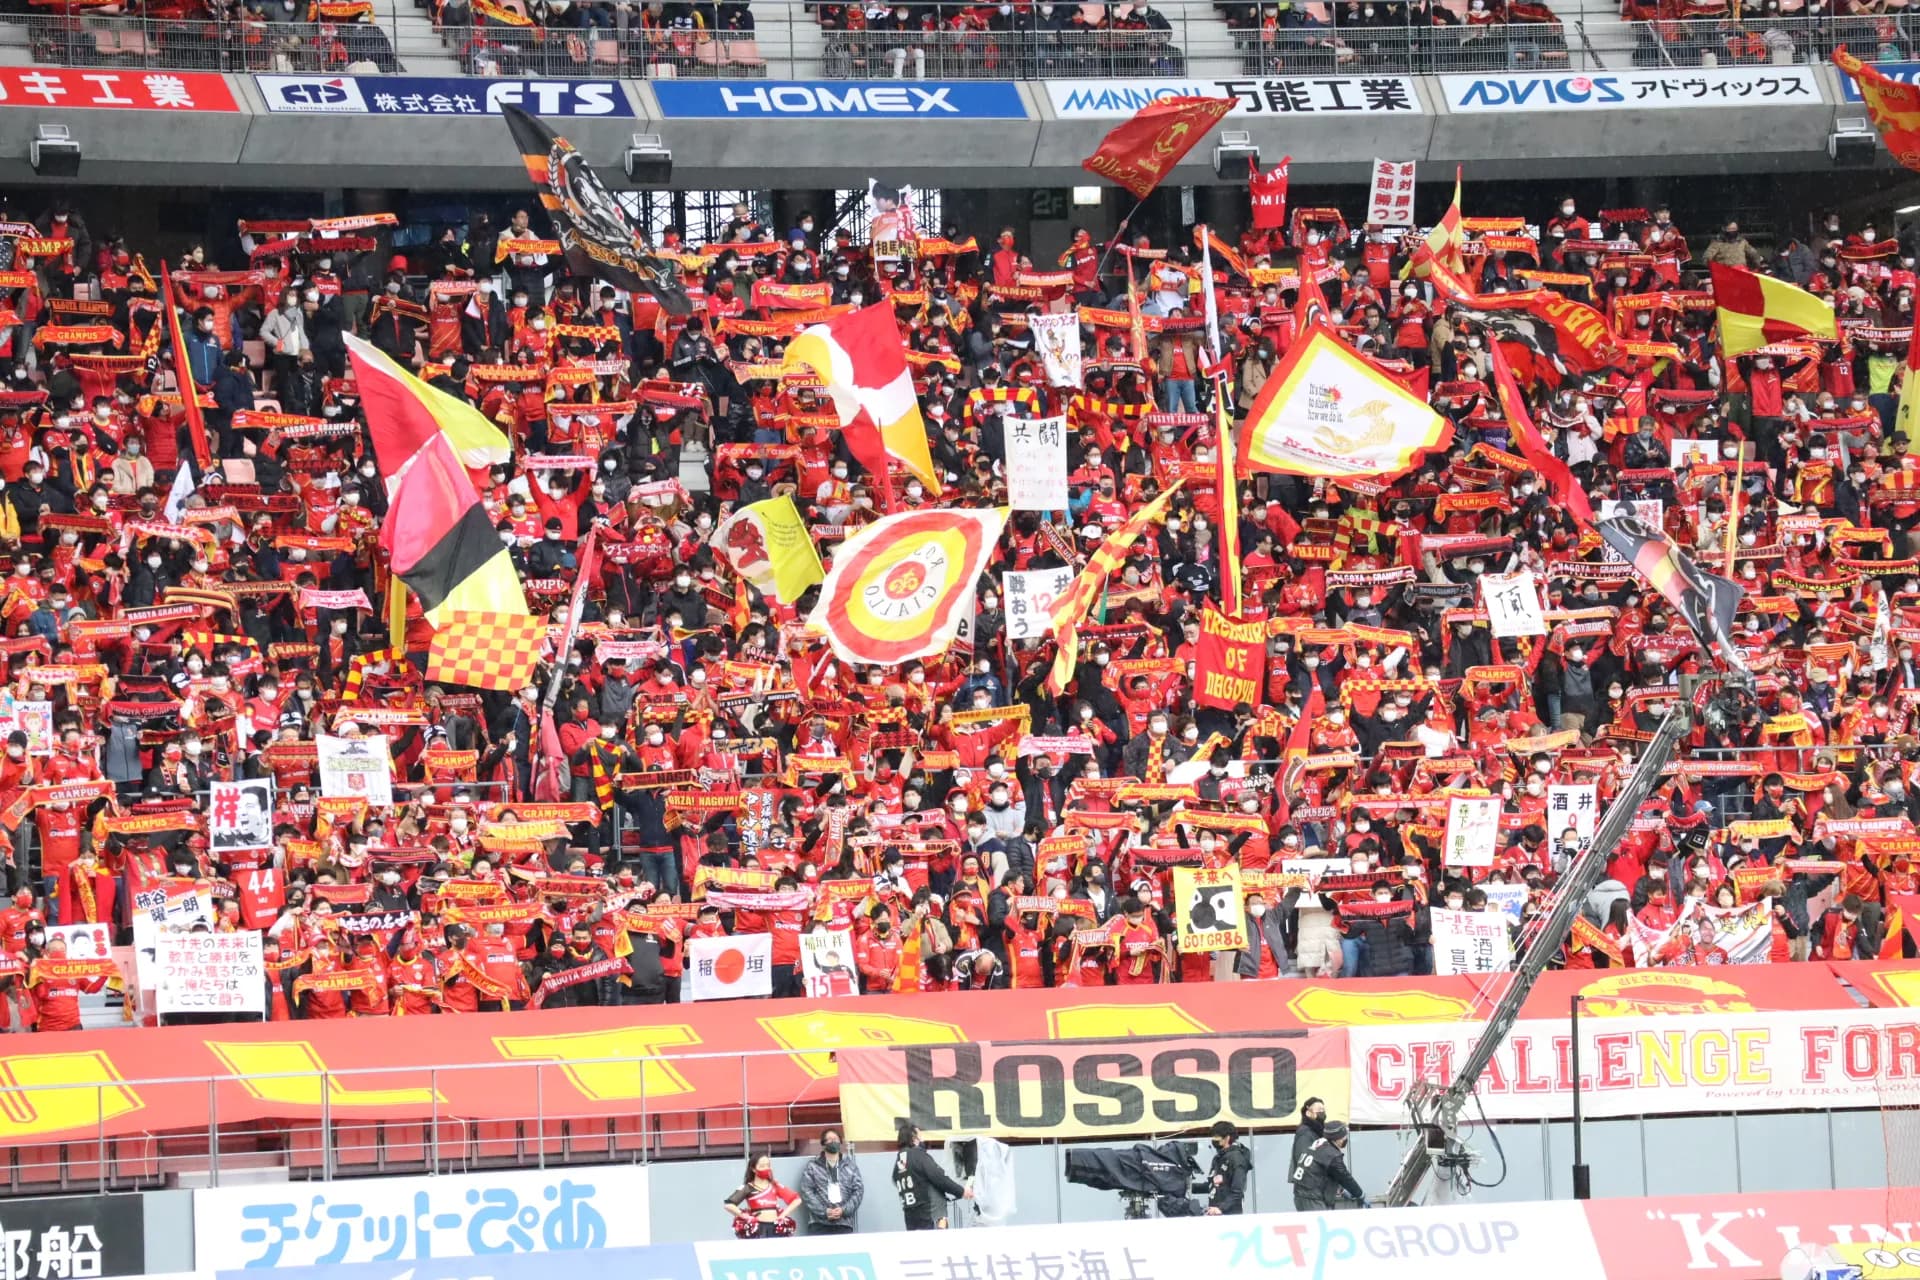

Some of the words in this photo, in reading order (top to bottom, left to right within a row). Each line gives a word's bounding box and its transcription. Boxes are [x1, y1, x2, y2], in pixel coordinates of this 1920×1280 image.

[0, 73, 195, 108] キ工業
[720, 86, 960, 113] HOMEX
[1213, 80, 1412, 113] 万能工業
[1458, 77, 1625, 106] ADVICS
[1631, 76, 1810, 104] アドヴィックス
[373, 93, 482, 114] 株式会社
[1032, 188, 1065, 215] 2F
[57, 331, 98, 342] GRAMPUS
[1853, 329, 1883, 339] NAGOYA
[1839, 366, 1849, 376] 12
[284, 424, 315, 435] NAGOYA
[800, 416, 839, 427] GRAMPUS
[1013, 421, 1060, 449] 共闘
[1488, 451, 1528, 470] GRAMPUS
[1452, 497, 1489, 507] GRAMPUS
[1558, 564, 1591, 574] NAGOYA
[1599, 564, 1634, 574] GRAMPUS
[128, 609, 157, 621] NAGOYA
[158, 604, 194, 618] GRAMPUS
[1008, 574, 1030, 637] 戦おう
[1031, 592, 1053, 613] 12
[1225, 647, 1248, 672] OF
[1475, 670, 1516, 680] GRAMPUS
[1205, 671, 1258, 705] NAGOYA
[430, 755, 475, 768] GRAMPUS
[50, 787, 101, 801] GRAMPUS
[1552, 793, 1594, 812] 酒井
[214, 787, 241, 829] 祥
[524, 810, 570, 822] GRAMPUS
[1458, 804, 1470, 830] 森下
[122, 819, 168, 831] GRAMPUS
[1826, 821, 1860, 834] NAGOYA
[1861, 820, 1902, 832] GRAMPUS
[1881, 841, 1920, 851] GRAMPU
[248, 868, 276, 896] 44
[136, 889, 167, 910] 柿谷
[151, 896, 200, 923] 曜一朗
[479, 908, 528, 921] GRAMPUS
[160, 936, 259, 950] 一寸先の未来に
[1183, 934, 1206, 950] GO!
[1207, 931, 1244, 948] GR86
[168, 951, 251, 964] 歓喜と勝利を
[1473, 937, 1494, 972] 酒井
[52, 965, 101, 977] GRAMPUS
[165, 966, 258, 979] つかみ獲るため
[544, 973, 580, 990] NAGOYA
[581, 961, 622, 979] GRAMPUS
[698, 958, 713, 977] 稲
[746, 956, 765, 974] 垣
[184, 979, 239, 992] 俺たちは
[810, 975, 831, 998] 15
[179, 993, 245, 1007] ここで闘う
[893, 1043, 1298, 1131] ROSSO
[240, 1177, 607, 1272] チケットぴあ
[1363, 1214, 1517, 1276] GROUP
[900, 1249, 1152, 1280] 三井住友海上
